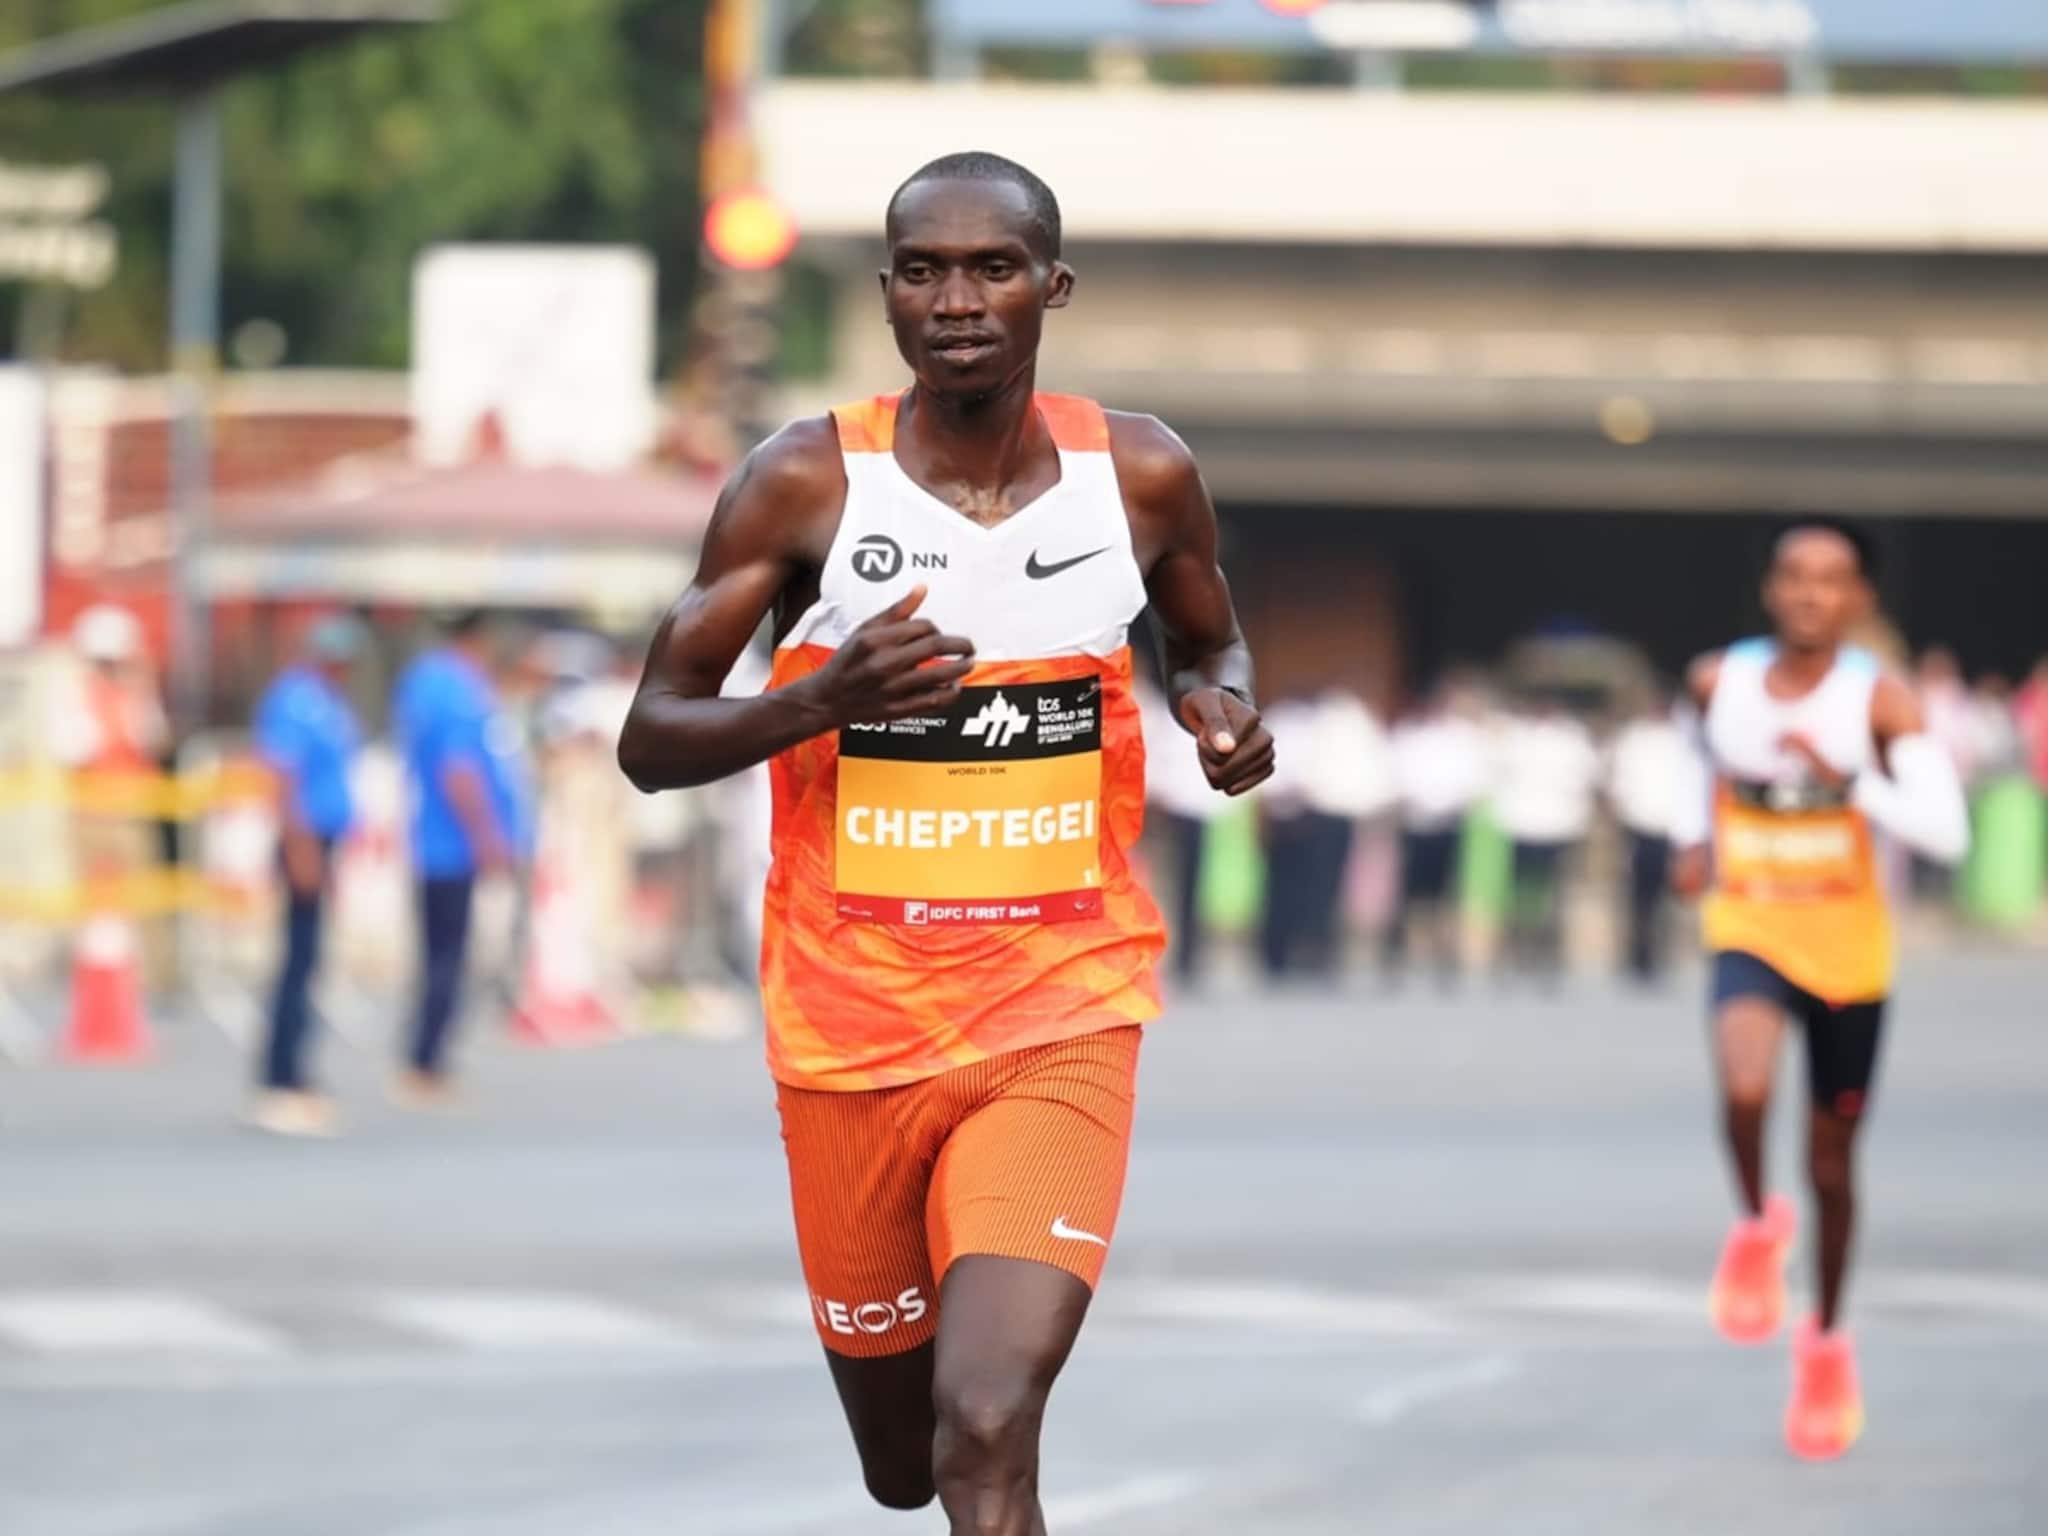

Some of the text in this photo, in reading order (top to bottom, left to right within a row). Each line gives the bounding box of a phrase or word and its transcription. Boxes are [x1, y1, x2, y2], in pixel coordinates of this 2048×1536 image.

[912, 553, 947, 569] NN
[1038, 710, 1076, 723] WORLD
[947, 767, 987, 776] WORLD
[846, 800, 1094, 849] CHEPTEGEI
[930, 905, 1041, 920] IDFC FIRST Bank
